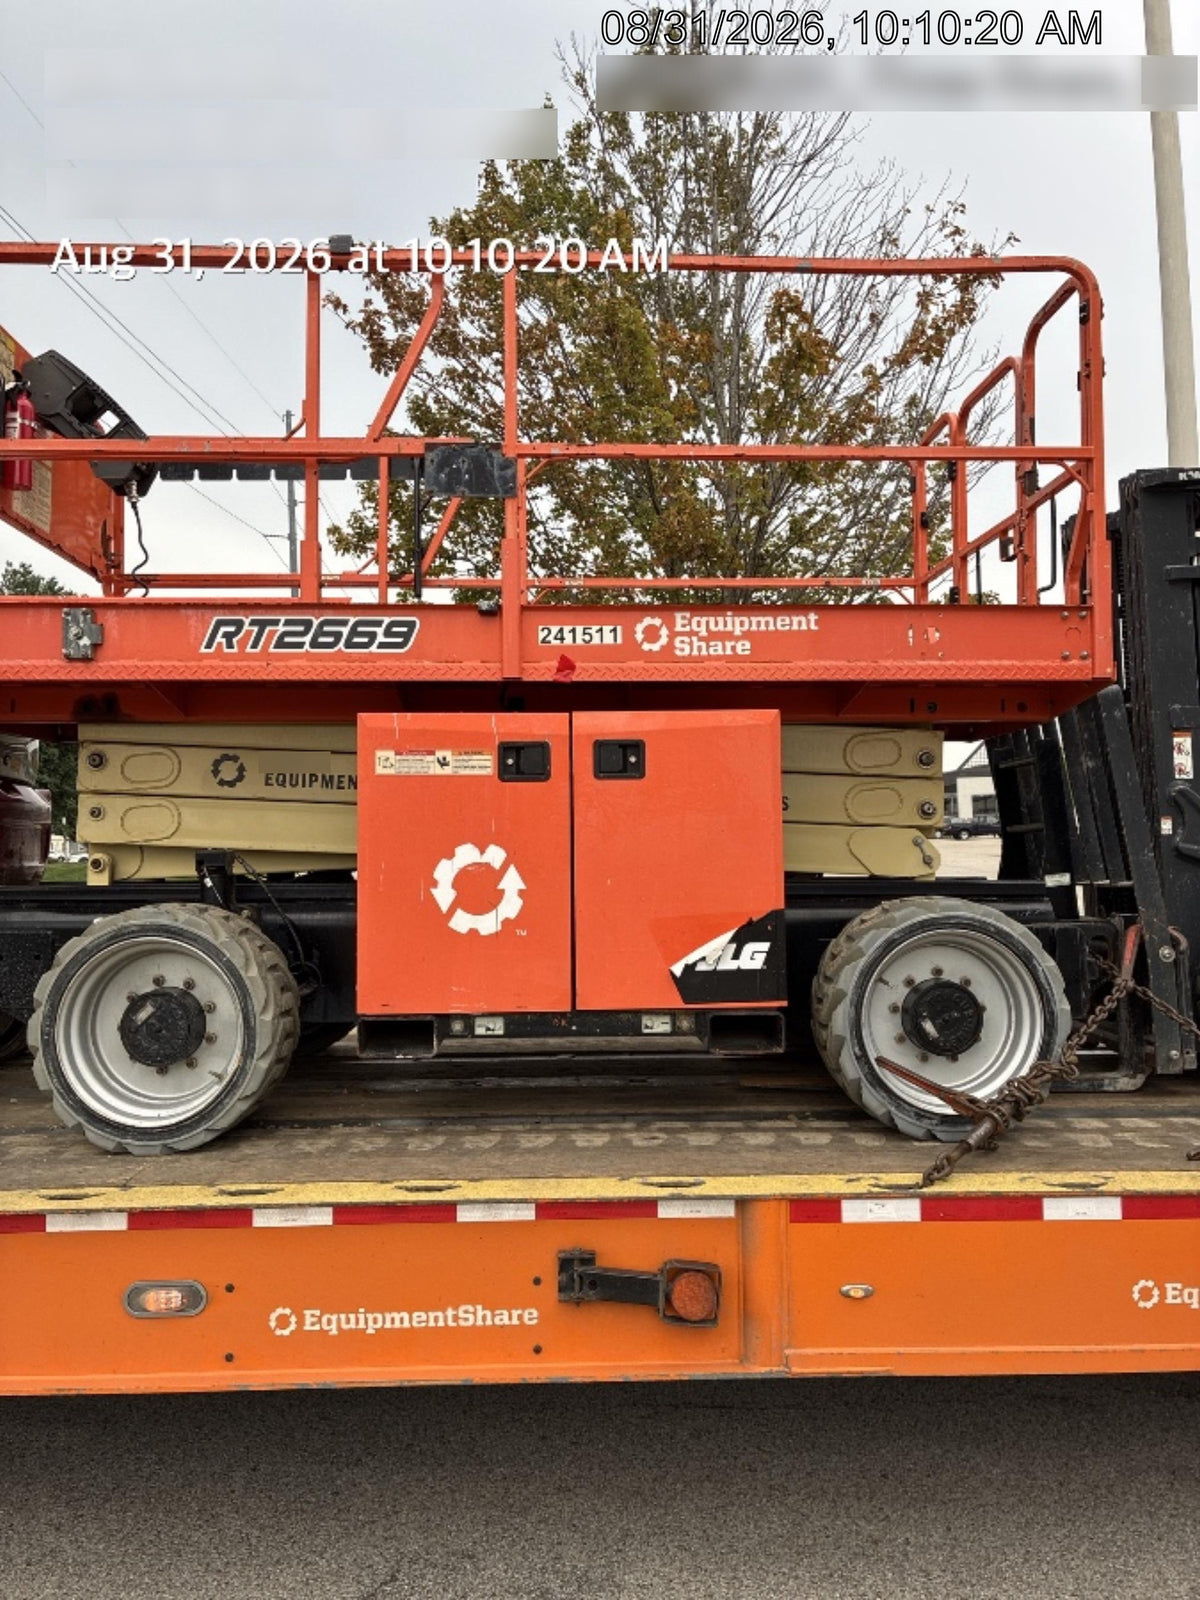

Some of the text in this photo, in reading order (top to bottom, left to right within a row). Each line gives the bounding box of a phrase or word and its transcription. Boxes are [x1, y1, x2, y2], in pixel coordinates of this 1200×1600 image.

[199, 616, 419, 653] RT2669
[539, 626, 621, 644] 241511
[673, 612, 819, 635] Equipment
[673, 636, 751, 656] Share
[303, 1304, 539, 1335] EquipmentShare
